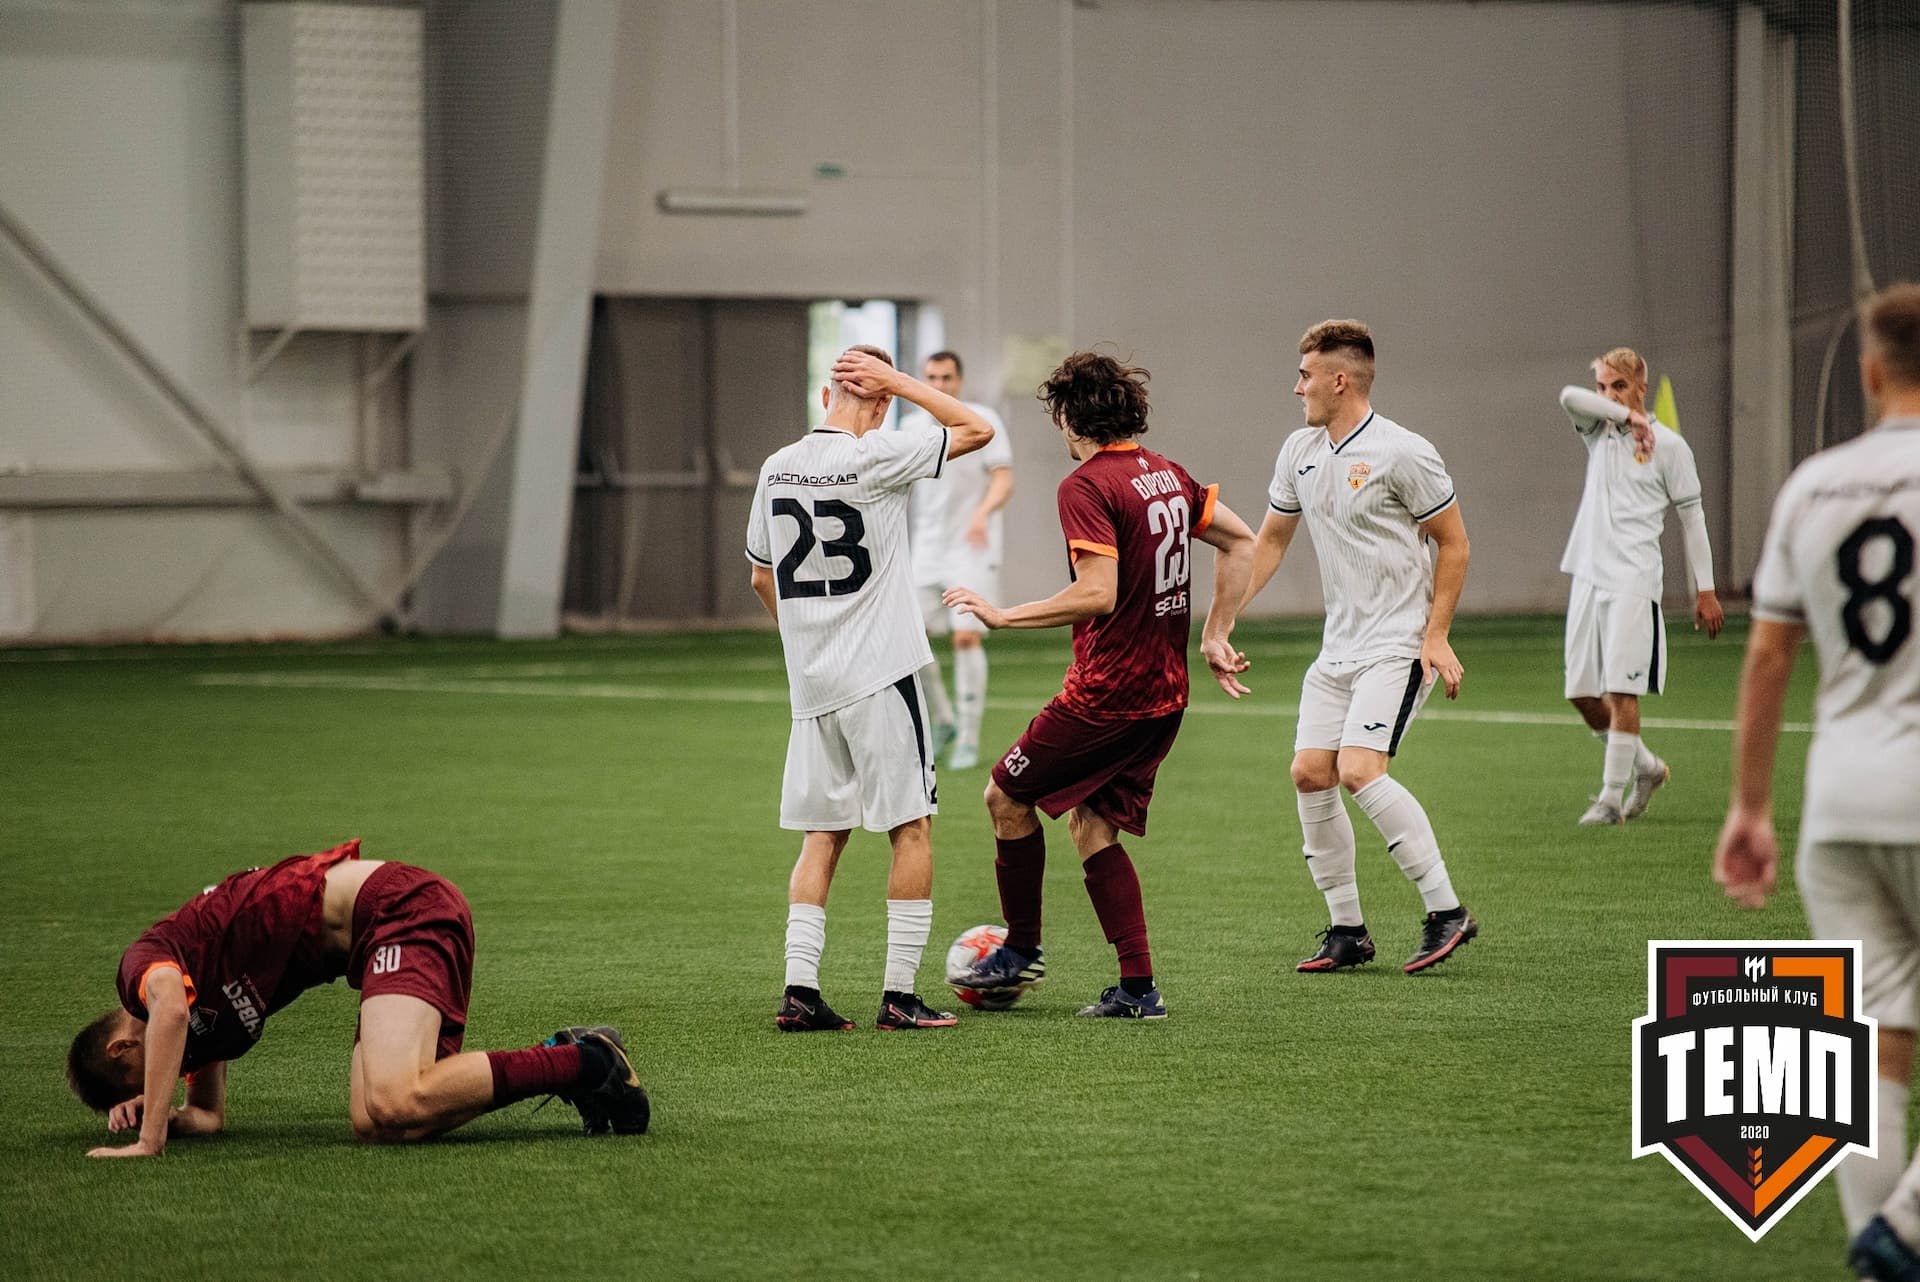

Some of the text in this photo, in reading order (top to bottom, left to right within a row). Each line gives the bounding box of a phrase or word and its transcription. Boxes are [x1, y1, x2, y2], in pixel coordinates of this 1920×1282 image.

[772, 498, 872, 600] 23
[1148, 496, 1190, 595] 23
[1838, 517, 1915, 666] 8
[1004, 746, 1030, 776] 23
[373, 945, 401, 974] 30
